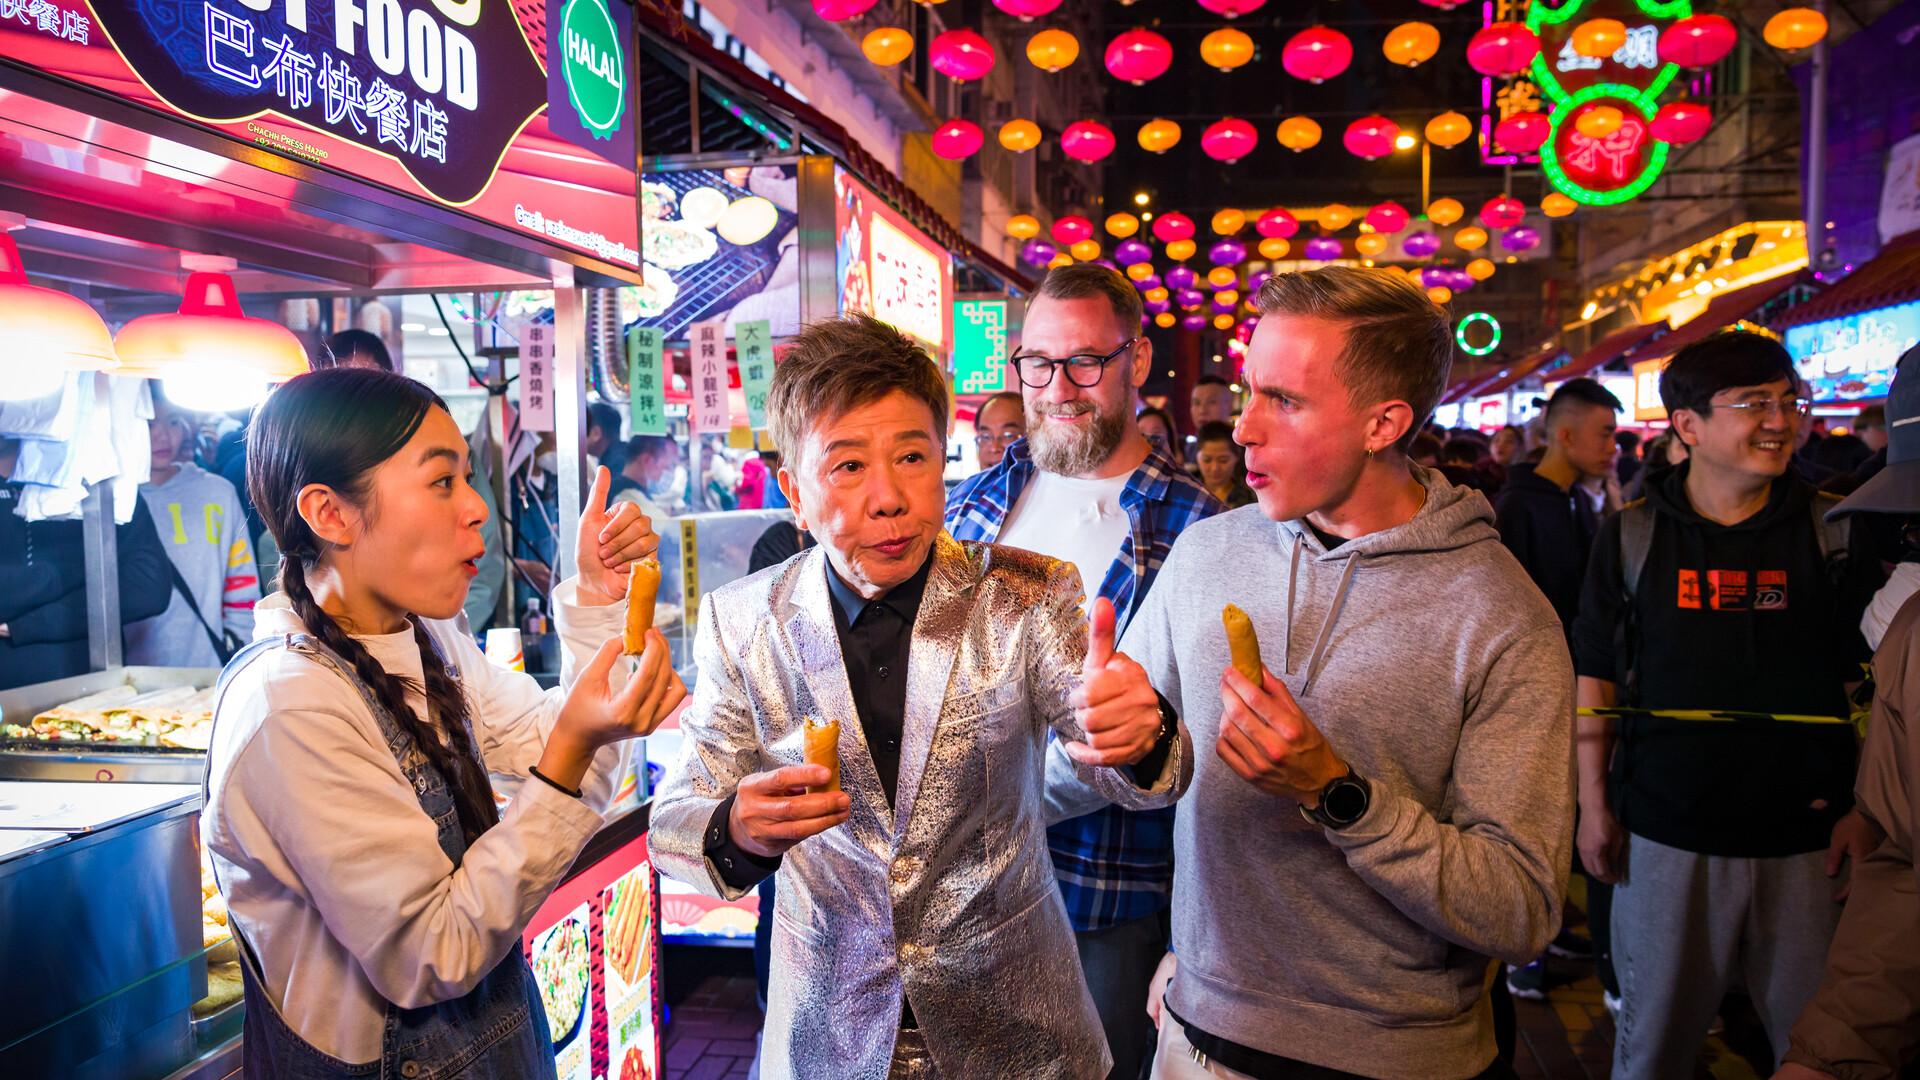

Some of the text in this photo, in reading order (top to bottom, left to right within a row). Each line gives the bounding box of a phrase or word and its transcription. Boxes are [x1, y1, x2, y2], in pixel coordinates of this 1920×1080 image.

[203, 1, 449, 164] 巴布快餐店
[335, 0, 479, 111] FOOD
[568, 27, 620, 89] HALAL
[529, 327, 544, 411] 串串香燒烤
